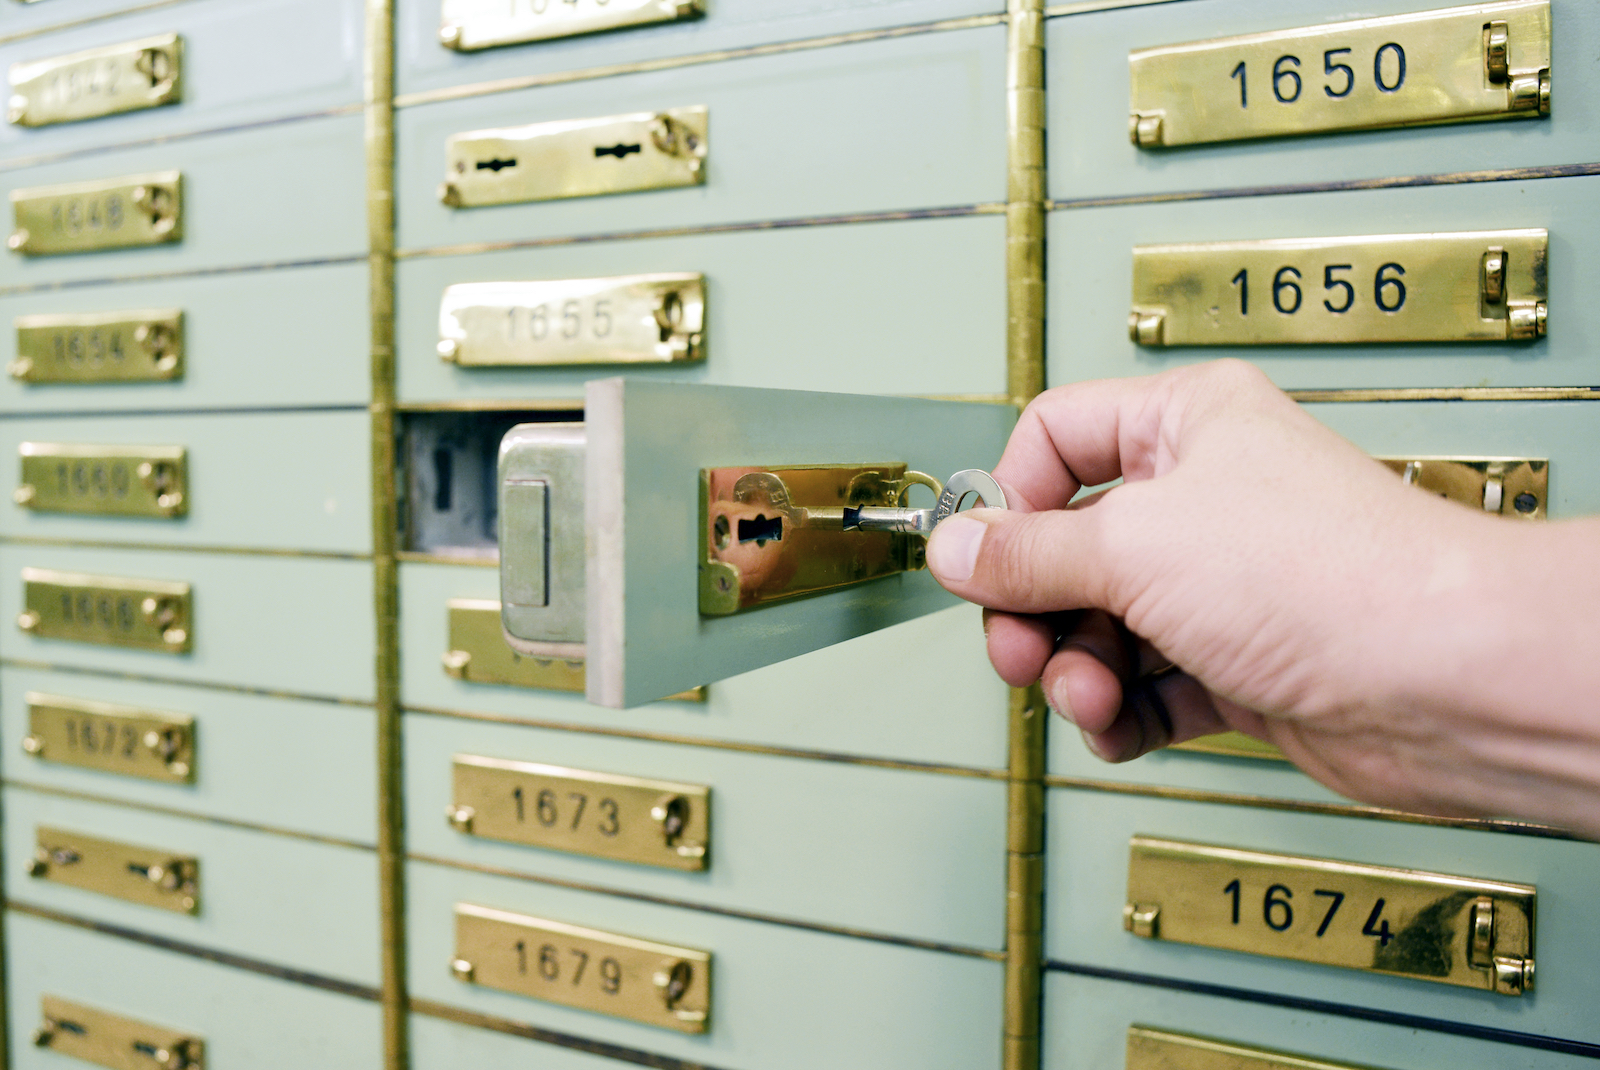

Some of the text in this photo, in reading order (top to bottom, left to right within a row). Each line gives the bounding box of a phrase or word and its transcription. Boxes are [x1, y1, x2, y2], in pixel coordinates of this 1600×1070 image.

[1230, 42, 1406, 109] 1650
[1230, 262, 1406, 315] 1656
[505, 299, 613, 341] 1655
[65, 717, 138, 759] 1672
[512, 786, 620, 836] 1673
[1224, 879, 1394, 947] 1674
[514, 940, 621, 995] 1679
